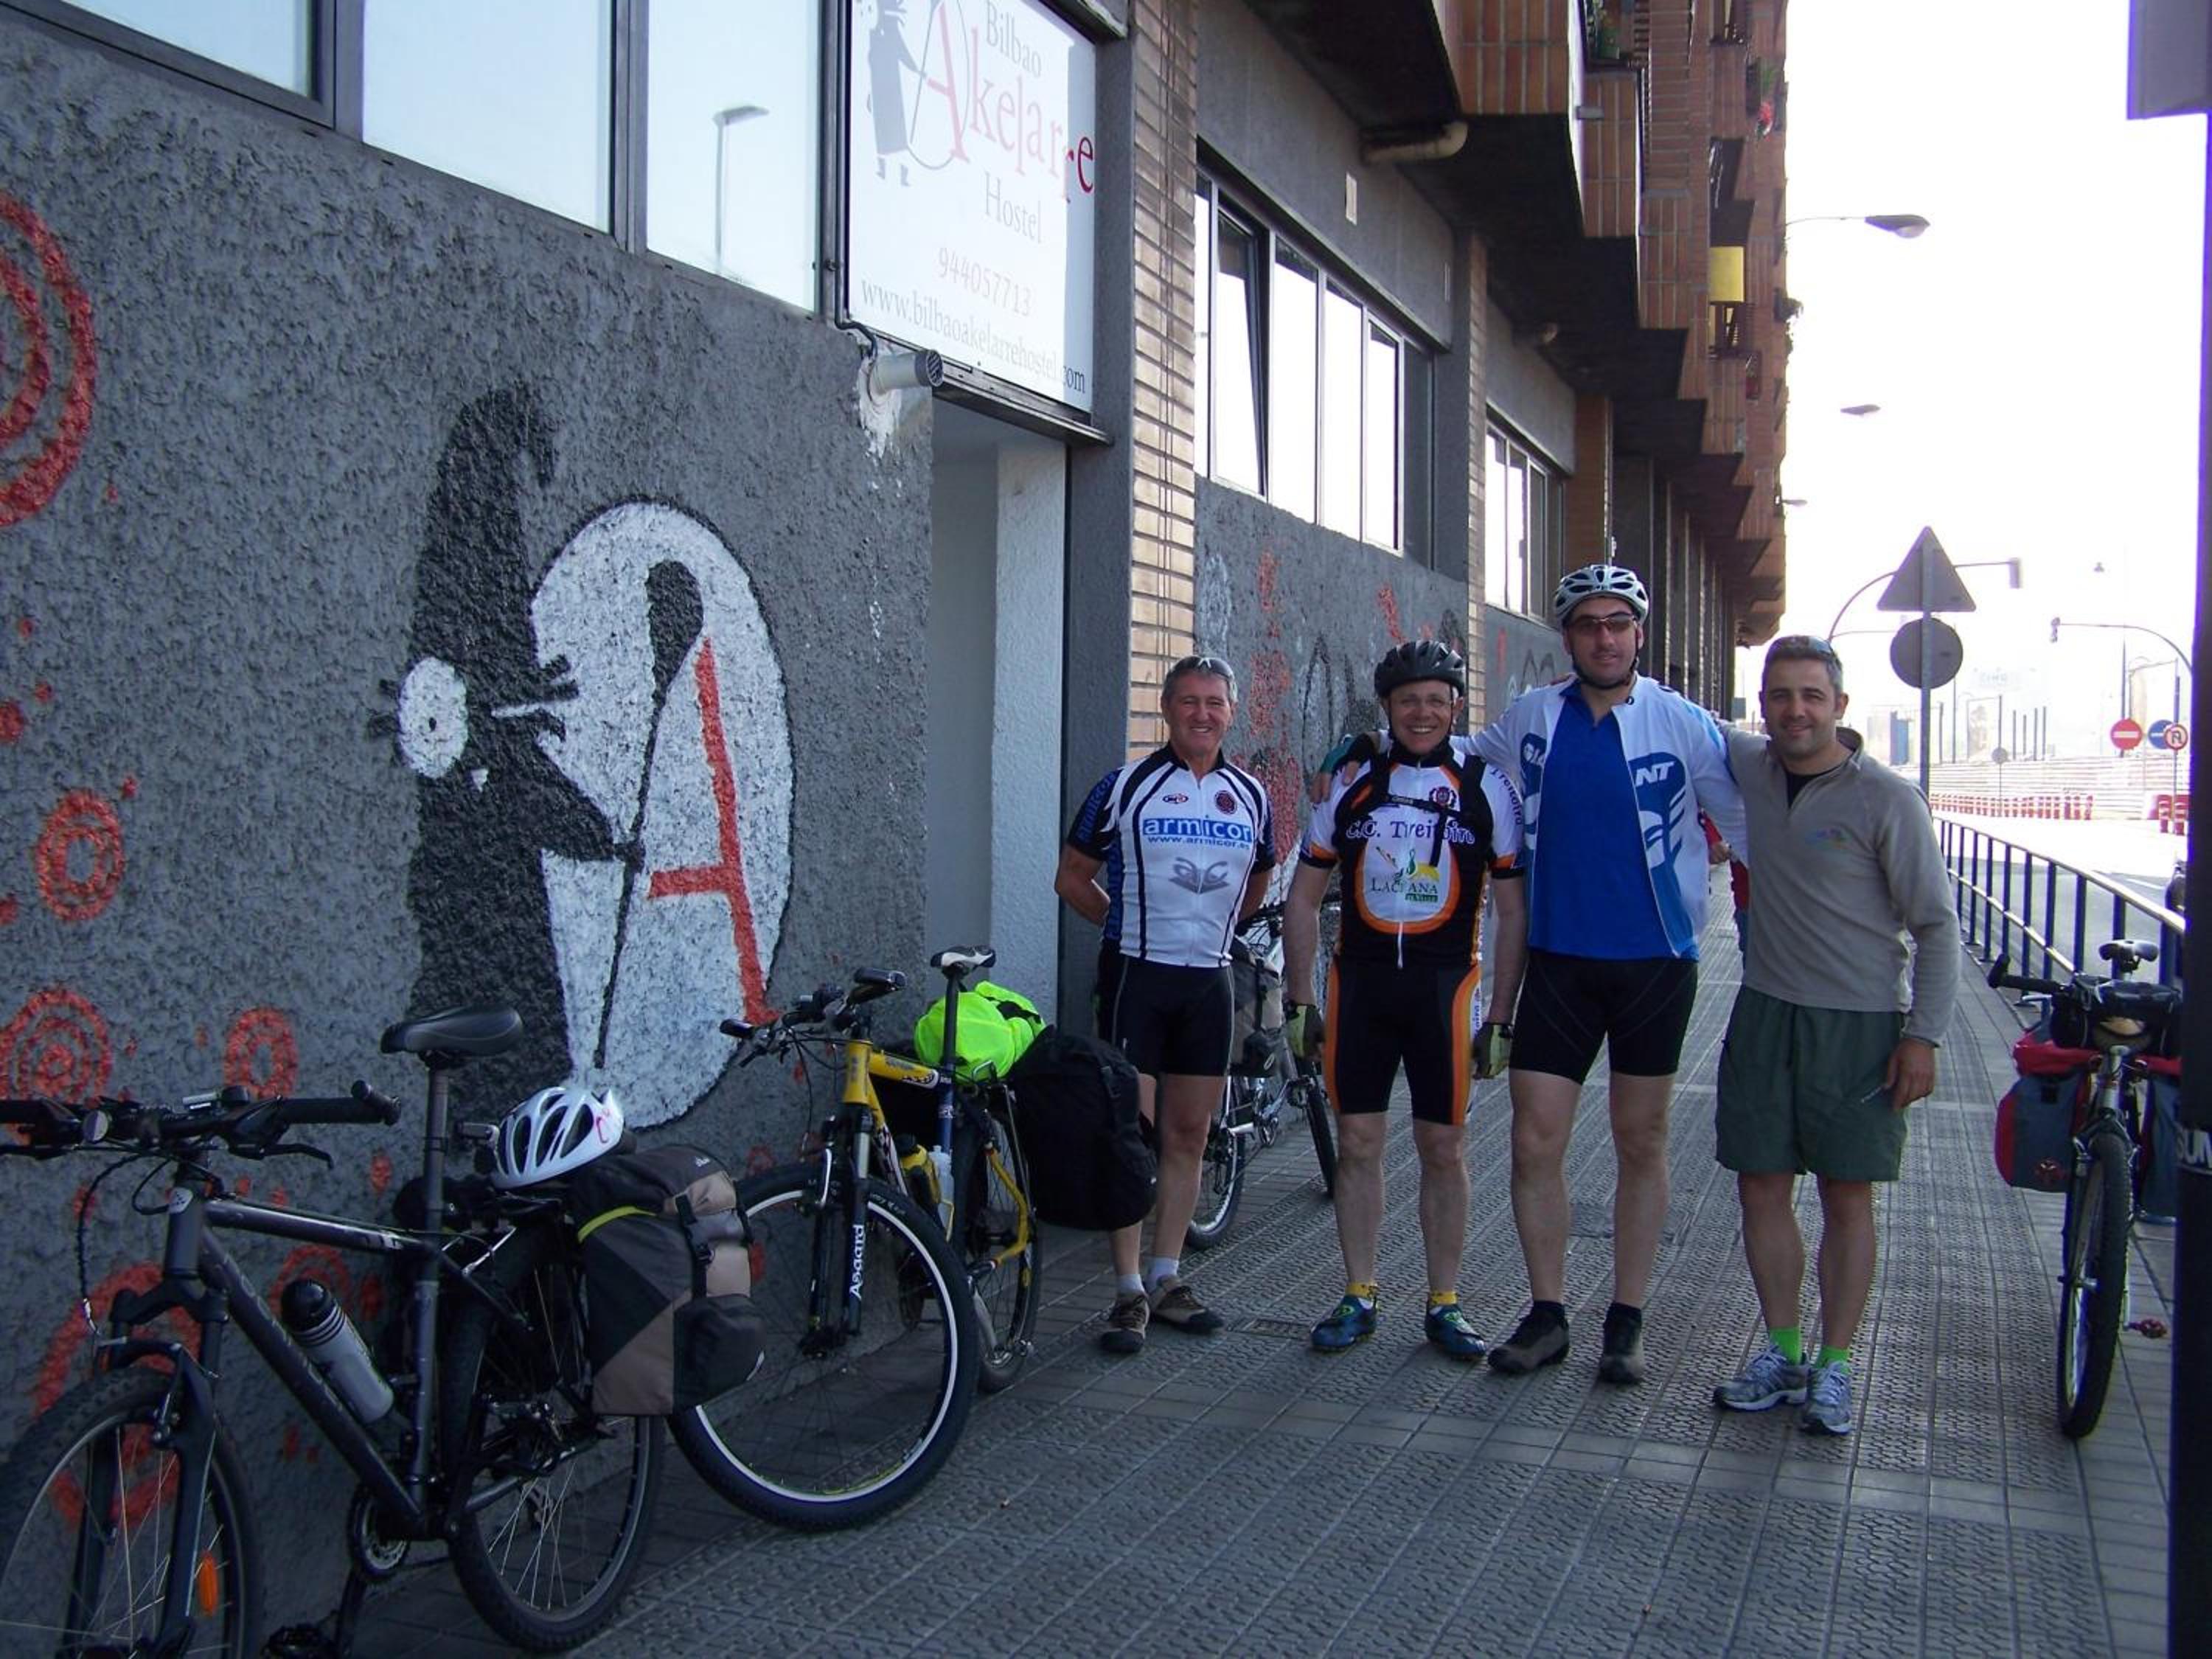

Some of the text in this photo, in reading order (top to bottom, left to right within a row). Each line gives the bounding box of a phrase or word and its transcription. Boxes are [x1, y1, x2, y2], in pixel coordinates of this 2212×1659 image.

[985, 0, 1043, 77] Bilbao
[985, 171, 1043, 244] Hostel
[938, 247, 1032, 318] 944057713
[1144, 815, 1251, 843] armicor
[849, 1224, 866, 1301] Asgard
